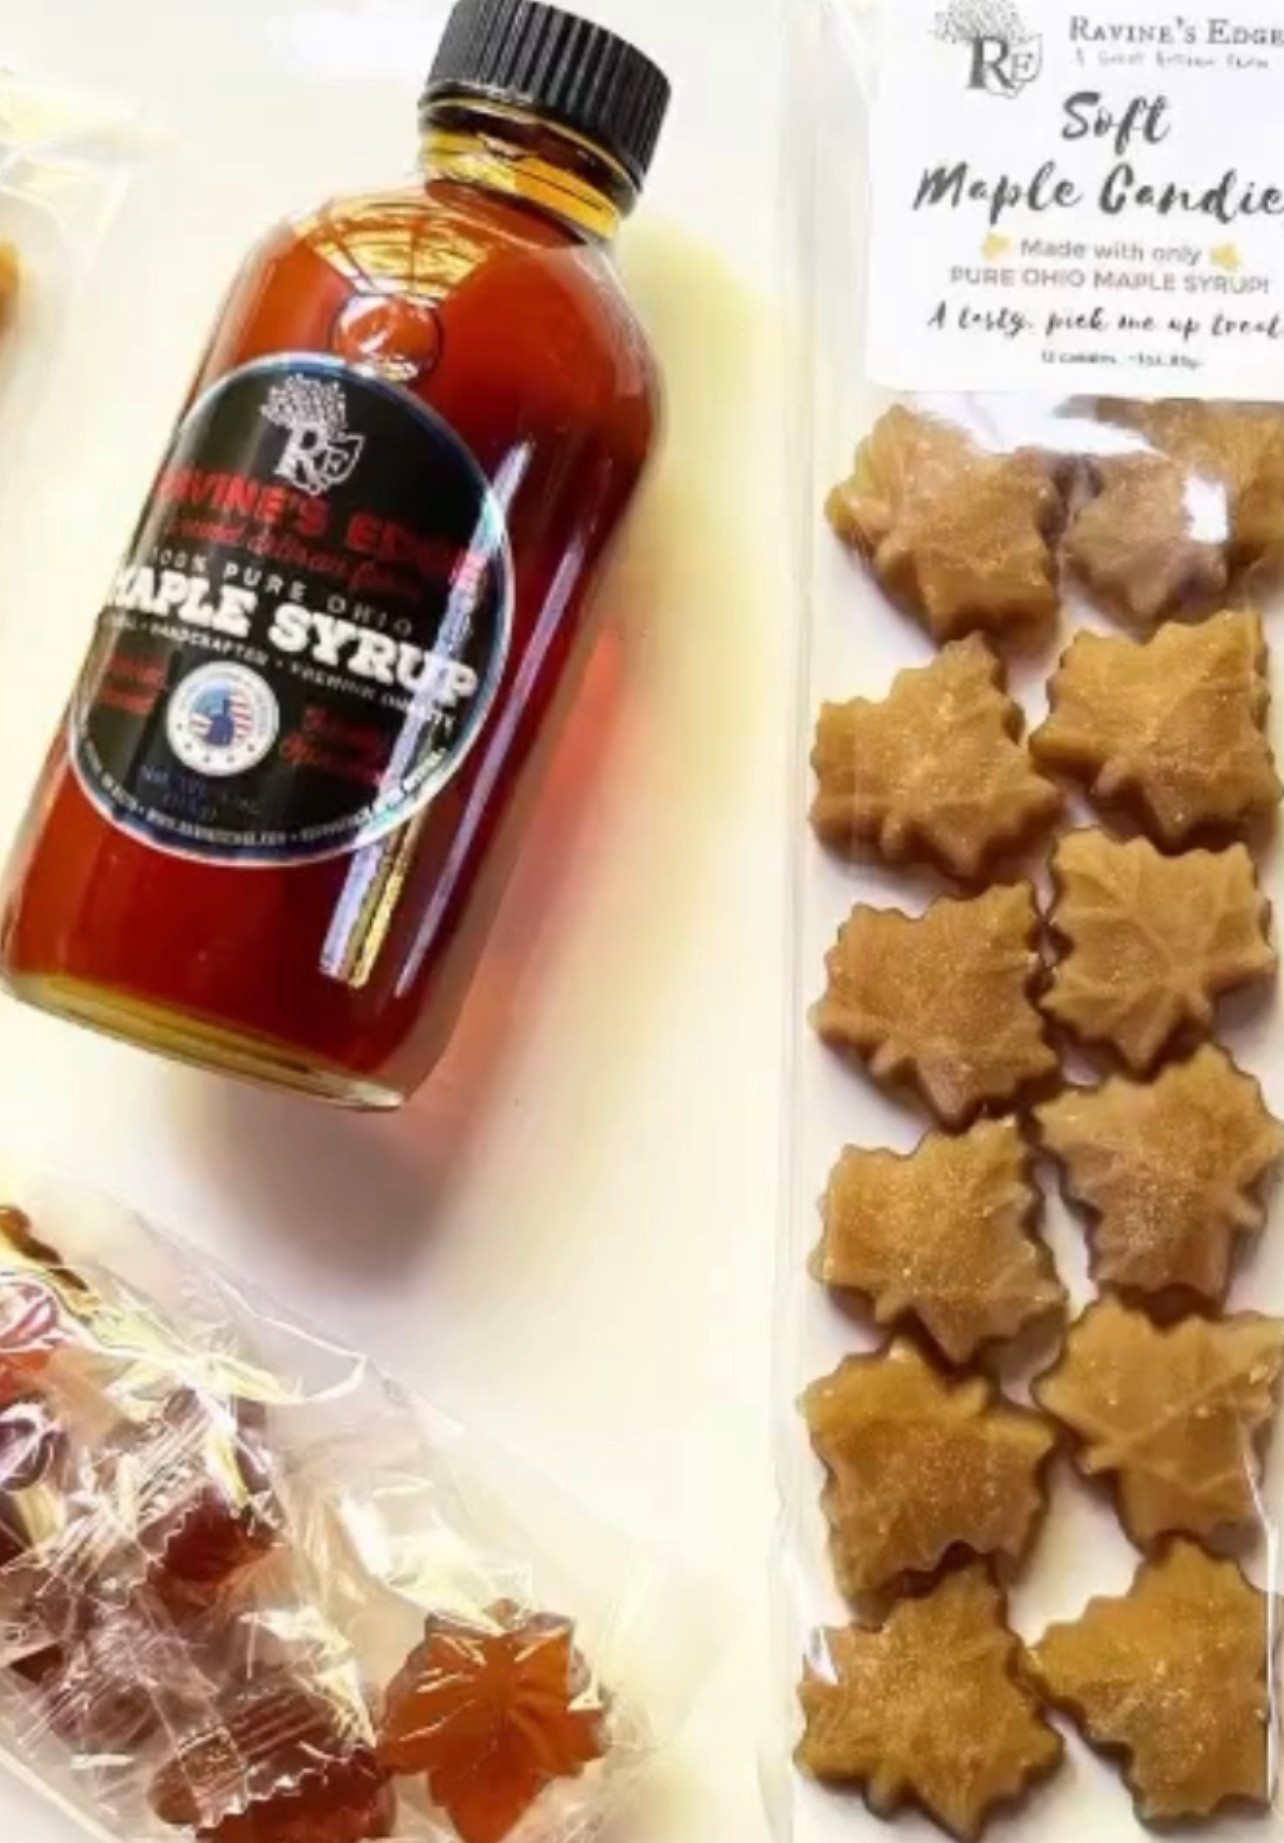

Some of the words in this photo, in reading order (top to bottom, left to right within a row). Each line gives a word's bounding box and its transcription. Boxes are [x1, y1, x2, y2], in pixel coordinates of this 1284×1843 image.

[1069, 15, 1197, 45] RAVINE'S
[1206, 18, 1284, 46] EDGE
[1062, 91, 1171, 155] Soft
[912, 160, 1083, 225] Maple
[1099, 162, 1284, 224] Candie
[950, 265, 1015, 288] PURE
[1023, 267, 1086, 288] OHIO
[1094, 269, 1176, 292] MAPLE
[1184, 273, 1270, 296] SYRUP!
[1020, 238, 1086, 260] Made
[1094, 240, 1144, 262] with
[1152, 245, 1203, 267] only
[927, 300, 946, 330] A
[1045, 306, 1106, 336] pick
[1117, 315, 1156, 332] me
[1168, 316, 1201, 342] up
[158, 467, 328, 537] AVINE'S
[222, 560, 308, 603] PURE
[326, 594, 413, 638] OHIO
[268, 602, 479, 708] SYRUP
